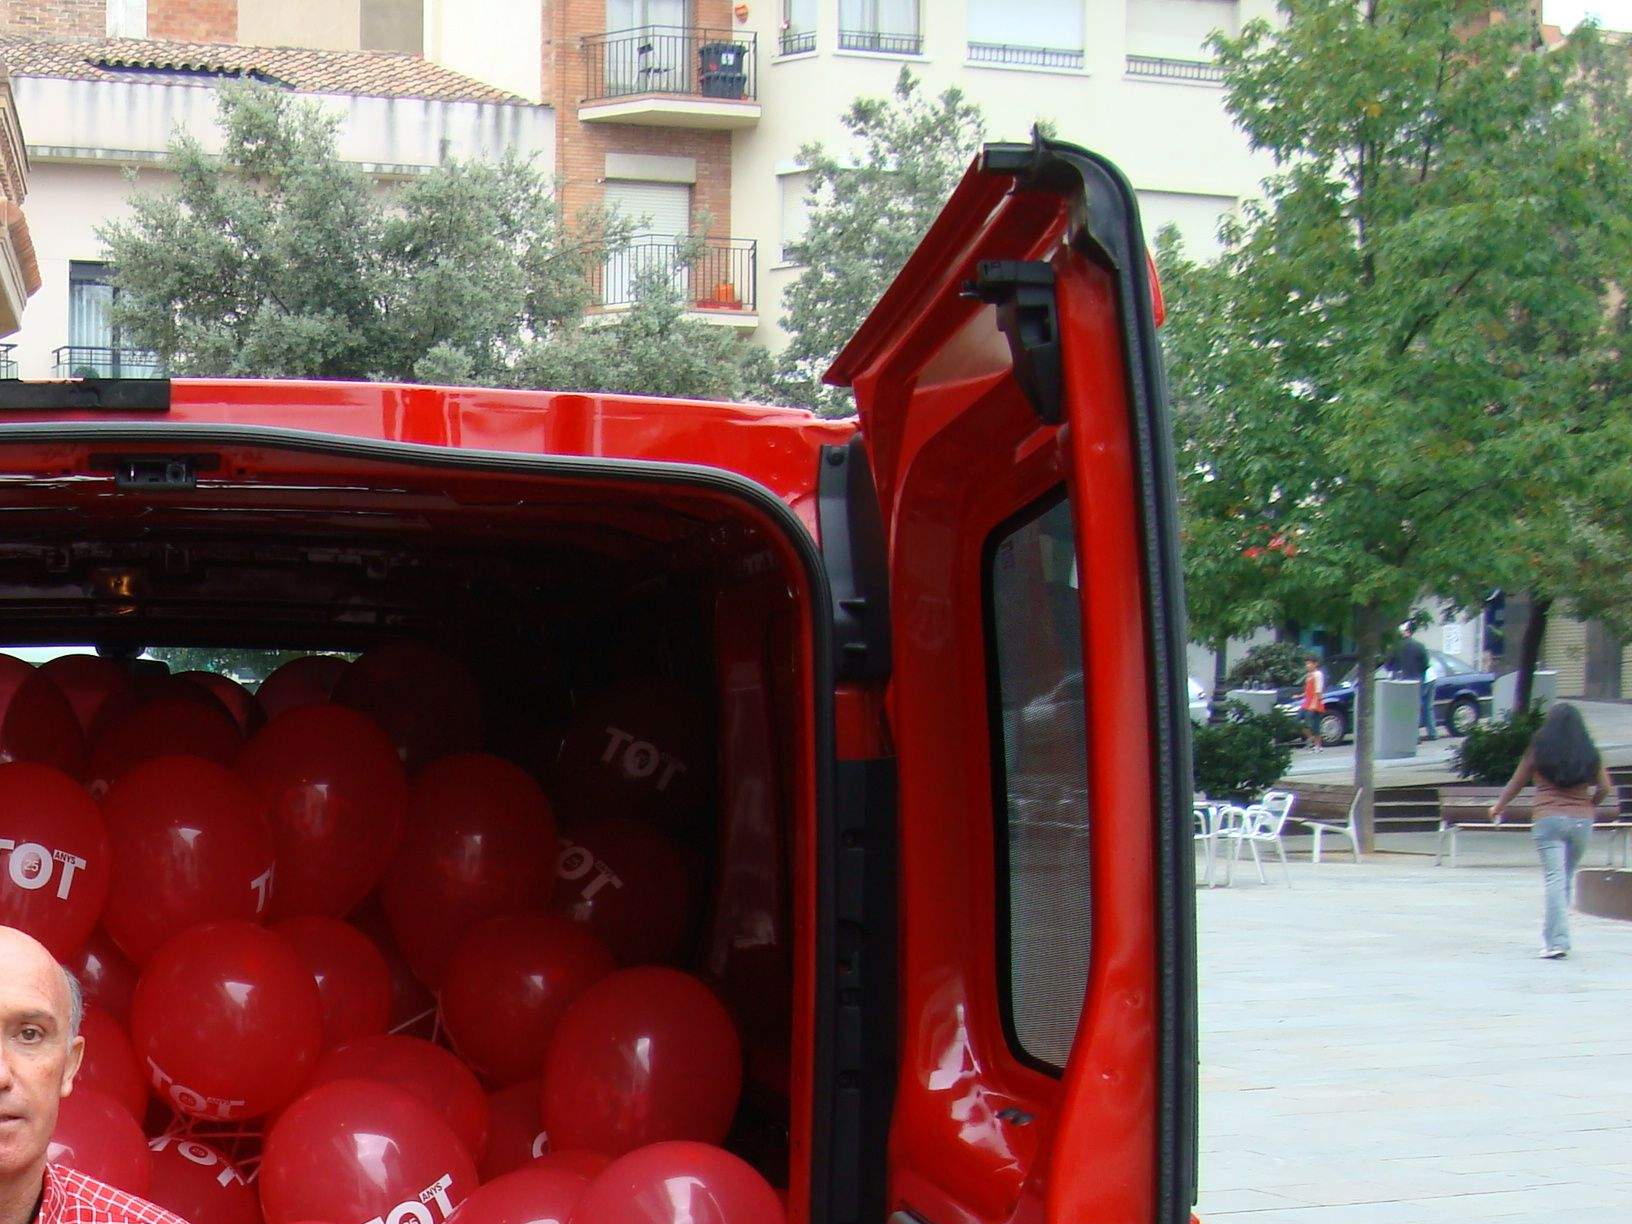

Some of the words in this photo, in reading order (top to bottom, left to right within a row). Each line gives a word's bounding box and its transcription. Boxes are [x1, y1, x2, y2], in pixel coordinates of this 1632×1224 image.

[601, 726, 687, 791] TOT
[54, 851, 76, 865] ANYS
[557, 838, 623, 899] OT
[421, 1182, 443, 1202] ANYS
